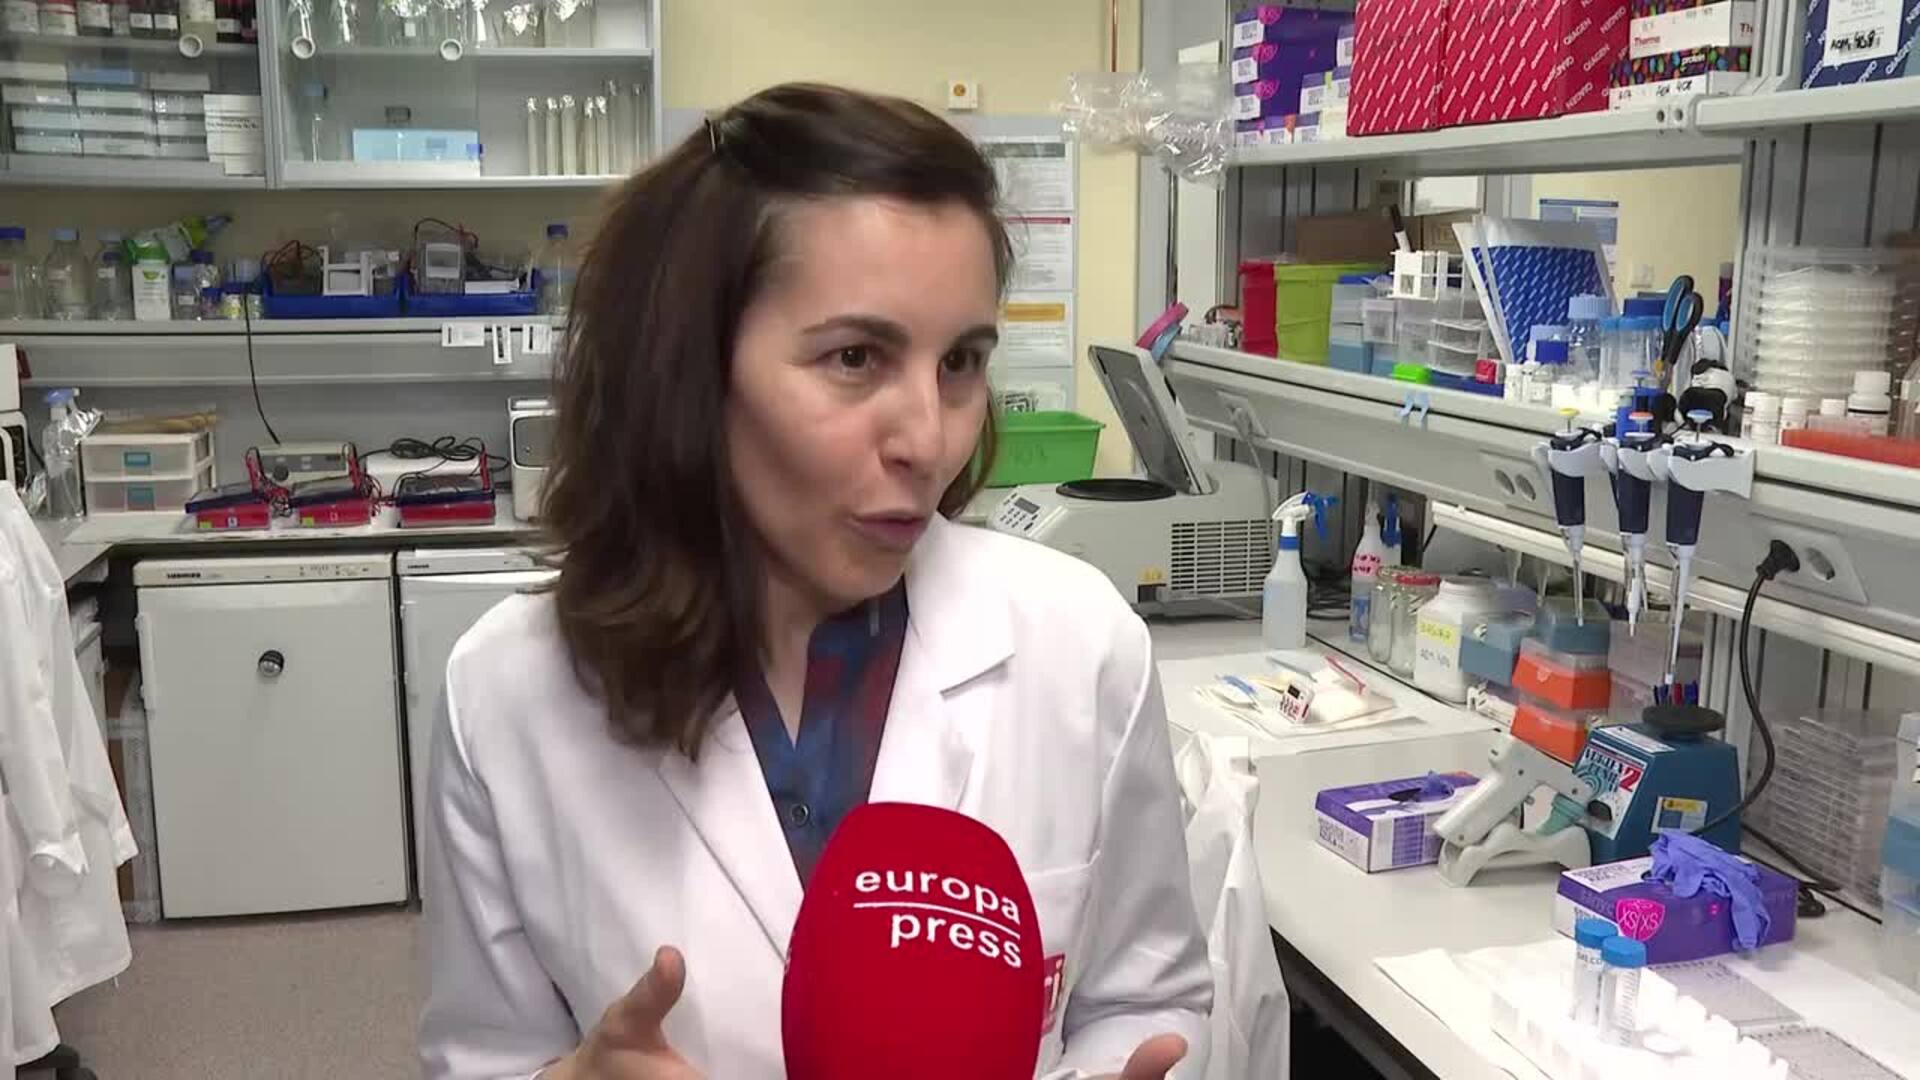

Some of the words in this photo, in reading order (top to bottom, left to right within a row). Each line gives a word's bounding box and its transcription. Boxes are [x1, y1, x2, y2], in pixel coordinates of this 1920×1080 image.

[1563, 17, 1592, 45] QIAGEN
[1583, 43, 1610, 72] QIAGEN
[1619, 767, 1642, 793] 2
[855, 870, 1021, 926] europa
[890, 913, 1022, 969] press
